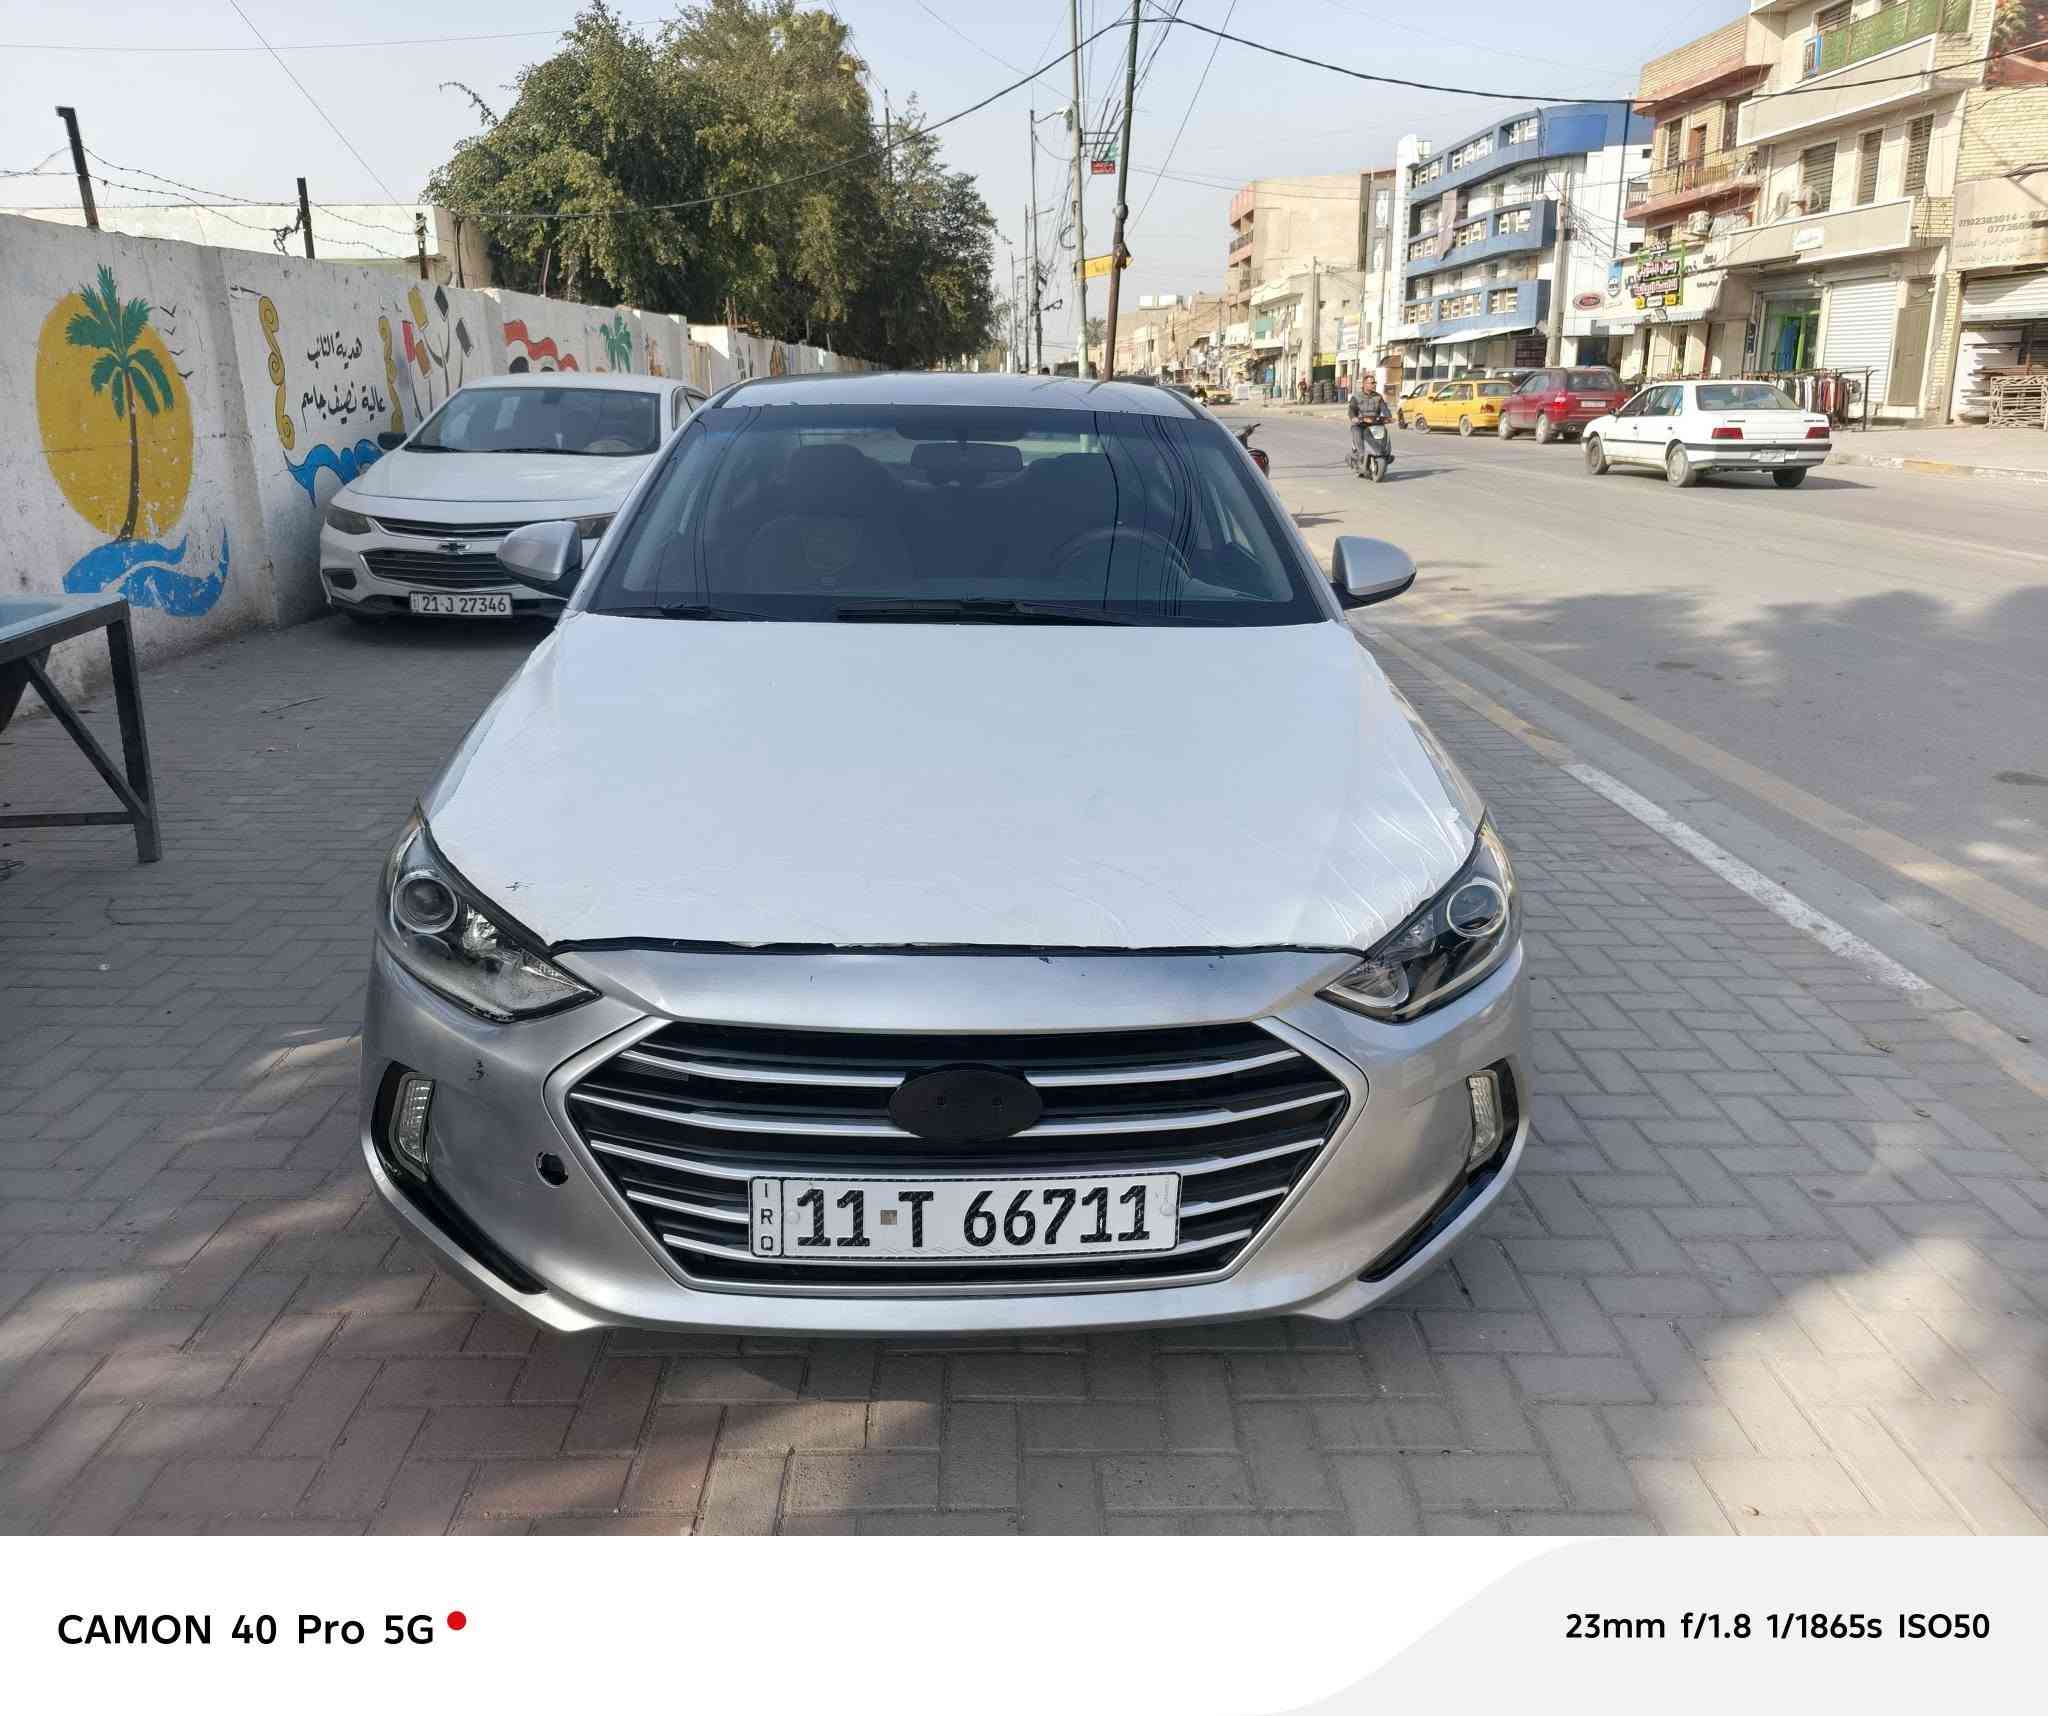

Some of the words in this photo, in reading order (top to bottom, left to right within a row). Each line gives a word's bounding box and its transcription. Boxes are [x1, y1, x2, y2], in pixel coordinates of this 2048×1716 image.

[336, 331, 363, 370] هدية
[361, 384, 386, 421] عالية
[422, 596, 440, 612] 21
[446, 597, 454, 613] J
[459, 597, 507, 613] 27346
[796, 1188, 871, 1248] 11
[898, 1190, 934, 1248] T
[963, 1184, 1151, 1248] 66711
